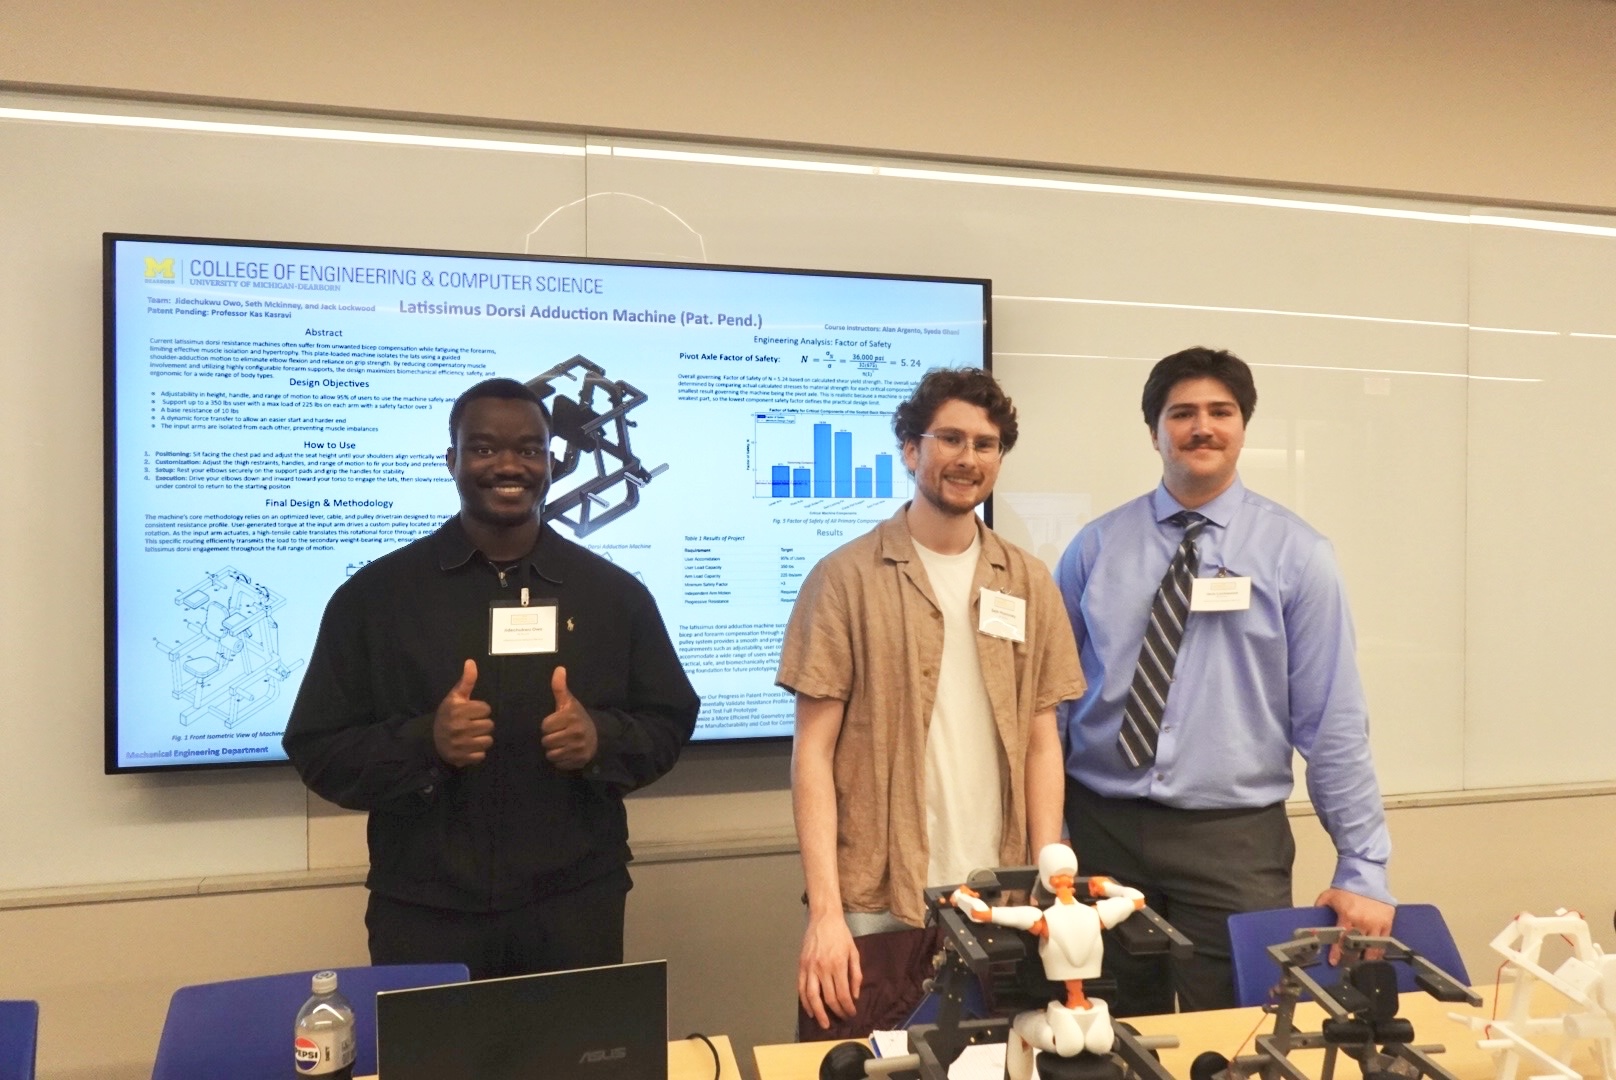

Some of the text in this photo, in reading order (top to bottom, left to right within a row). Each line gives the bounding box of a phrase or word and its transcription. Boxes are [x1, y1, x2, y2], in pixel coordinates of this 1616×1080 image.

[190, 259, 604, 294] COLLEGE OF ENGINEERING & COMPUTER SCIENCE
[190, 278, 238, 286] UNIVERSITY
[262, 301, 303, 310] Mckinney,
[174, 308, 209, 317] Pending:
[399, 299, 762, 329] Latissimus Dorsi Adduction Machine (Pat. Pend.)
[305, 328, 342, 336] Abstract
[753, 337, 798, 345] Engineering
[800, 337, 832, 346] Analysis:
[868, 340, 891, 348] Safety
[289, 378, 369, 388] Design Objectives
[289, 499, 320, 508] Design
[333, 499, 393, 508] Methodology
[126, 746, 268, 758] Mechanical Engineering Department
[580, 1047, 626, 1064] ASUS
